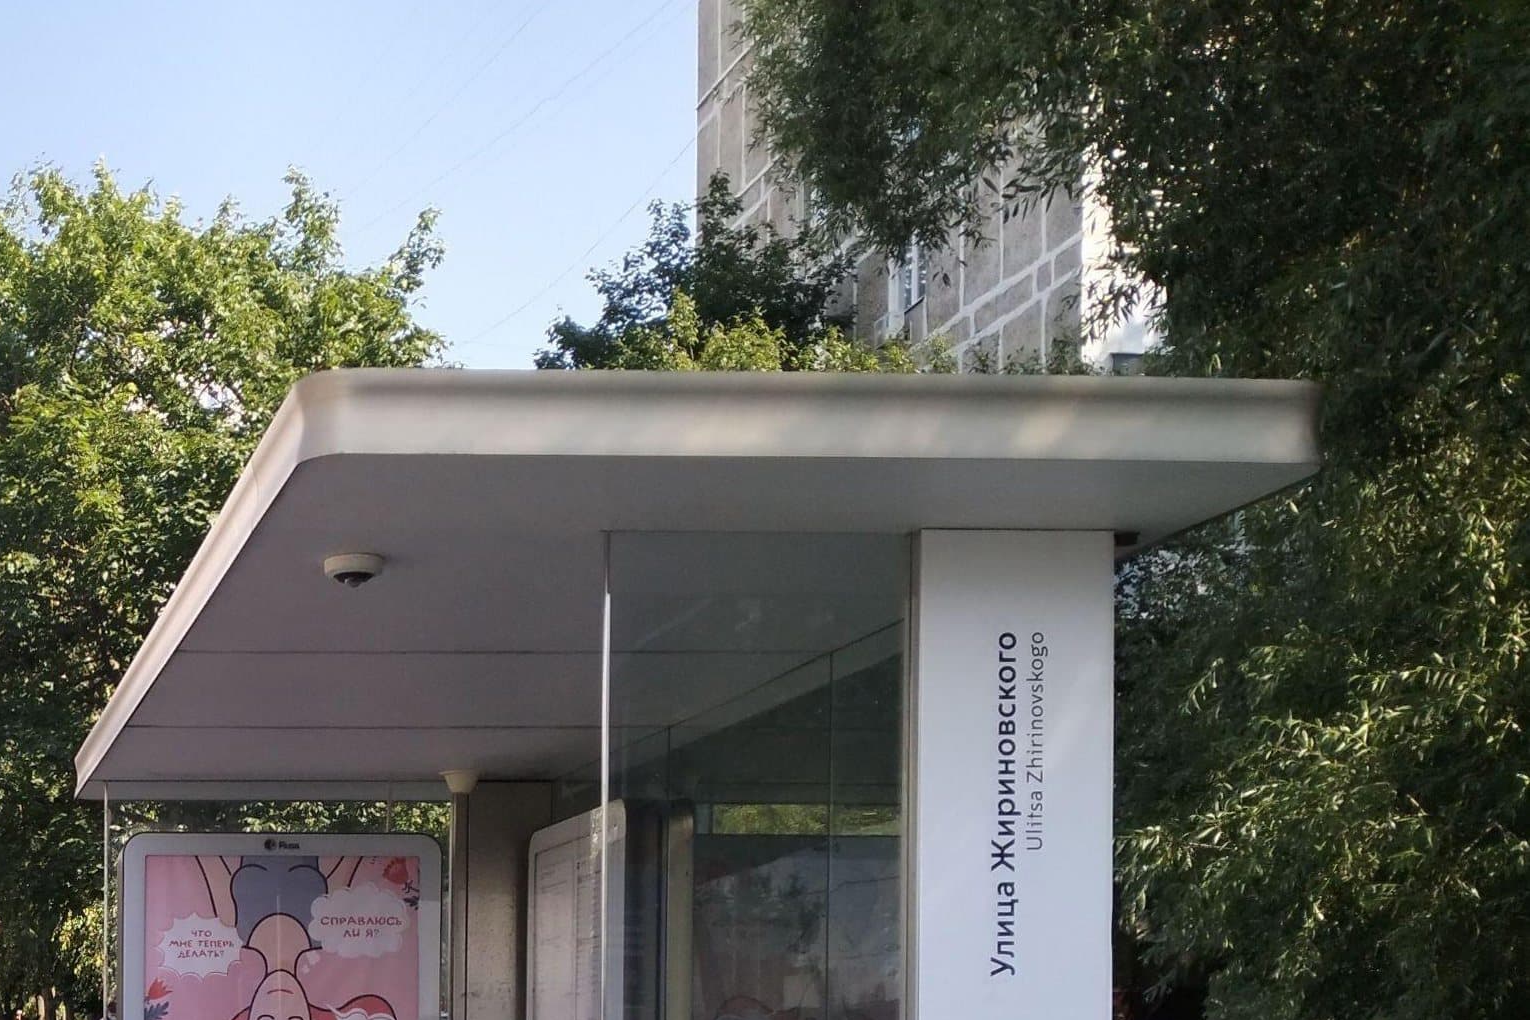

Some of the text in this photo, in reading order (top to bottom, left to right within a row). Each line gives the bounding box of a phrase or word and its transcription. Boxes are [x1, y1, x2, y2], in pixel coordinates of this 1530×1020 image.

[1025, 632, 1048, 850] Ulitsa Zhirinovskogo
[990, 632, 1021, 977] Улица Жириновского
[320, 915, 402, 926] СПРАВЛЮСЬ
[190, 929, 212, 938] ЧТО
[343, 929, 380, 938] ЛИ Я?
[169, 939, 235, 949] МНЕ ТЕПЕРЬ
[177, 949, 225, 959] ДЕЛАТЬ?
